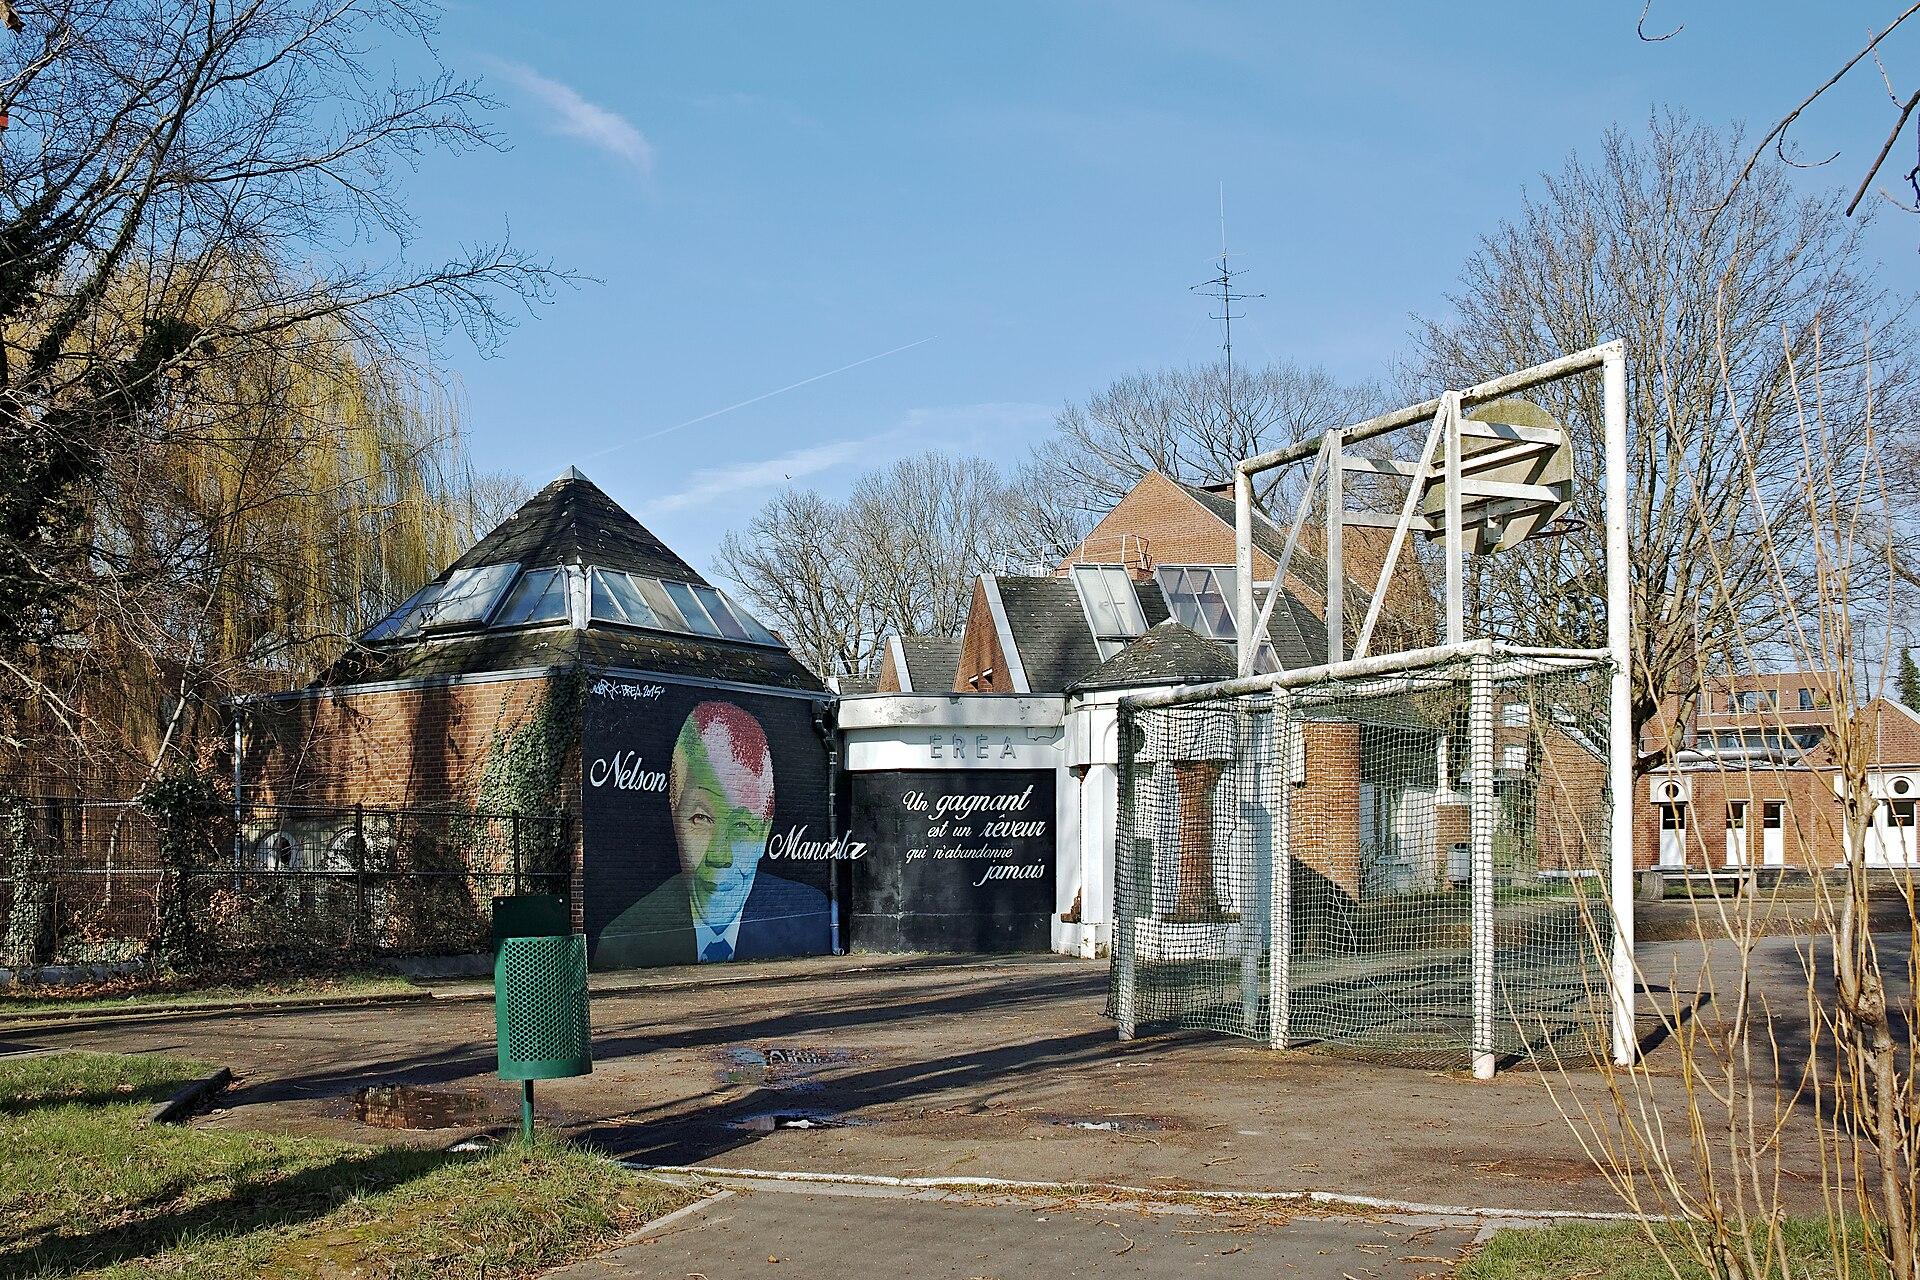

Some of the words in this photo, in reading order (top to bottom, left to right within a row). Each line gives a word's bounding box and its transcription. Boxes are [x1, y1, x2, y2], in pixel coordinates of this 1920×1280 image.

[930, 734, 1017, 759] EREA
[590, 750, 667, 792] Nelson
[902, 790, 929, 811] Un
[928, 784, 1034, 820] gagnant
[927, 820, 949, 837] est
[952, 825, 972, 837] un
[979, 813, 1046, 837] rêveur
[906, 844, 929, 864] qui
[933, 843, 1013, 859] n'abandonne
[972, 858, 1045, 886] jamais
